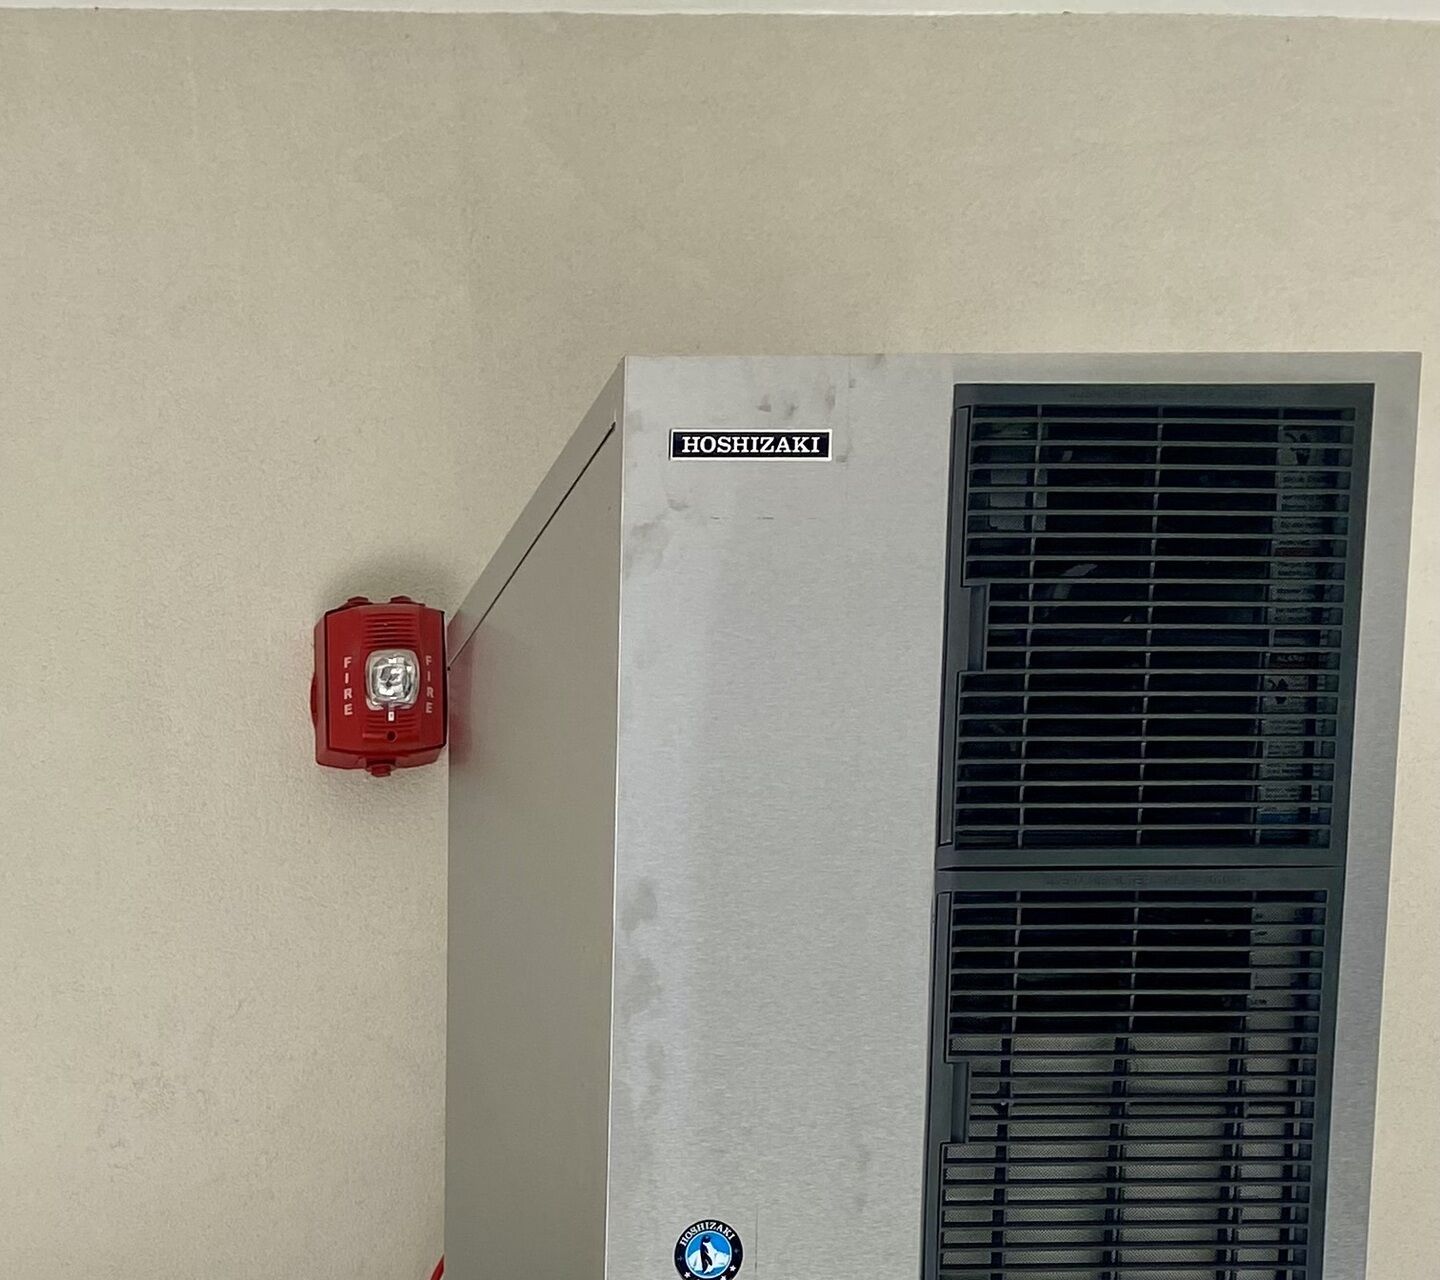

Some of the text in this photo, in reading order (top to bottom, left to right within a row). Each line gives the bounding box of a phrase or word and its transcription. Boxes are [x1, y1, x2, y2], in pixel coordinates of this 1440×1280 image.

[681, 436, 820, 453] HOSHIZAKI
[343, 656, 353, 716] FIRE
[425, 655, 434, 714] FIRE
[679, 1221, 736, 1247] HOSHIZAKI
